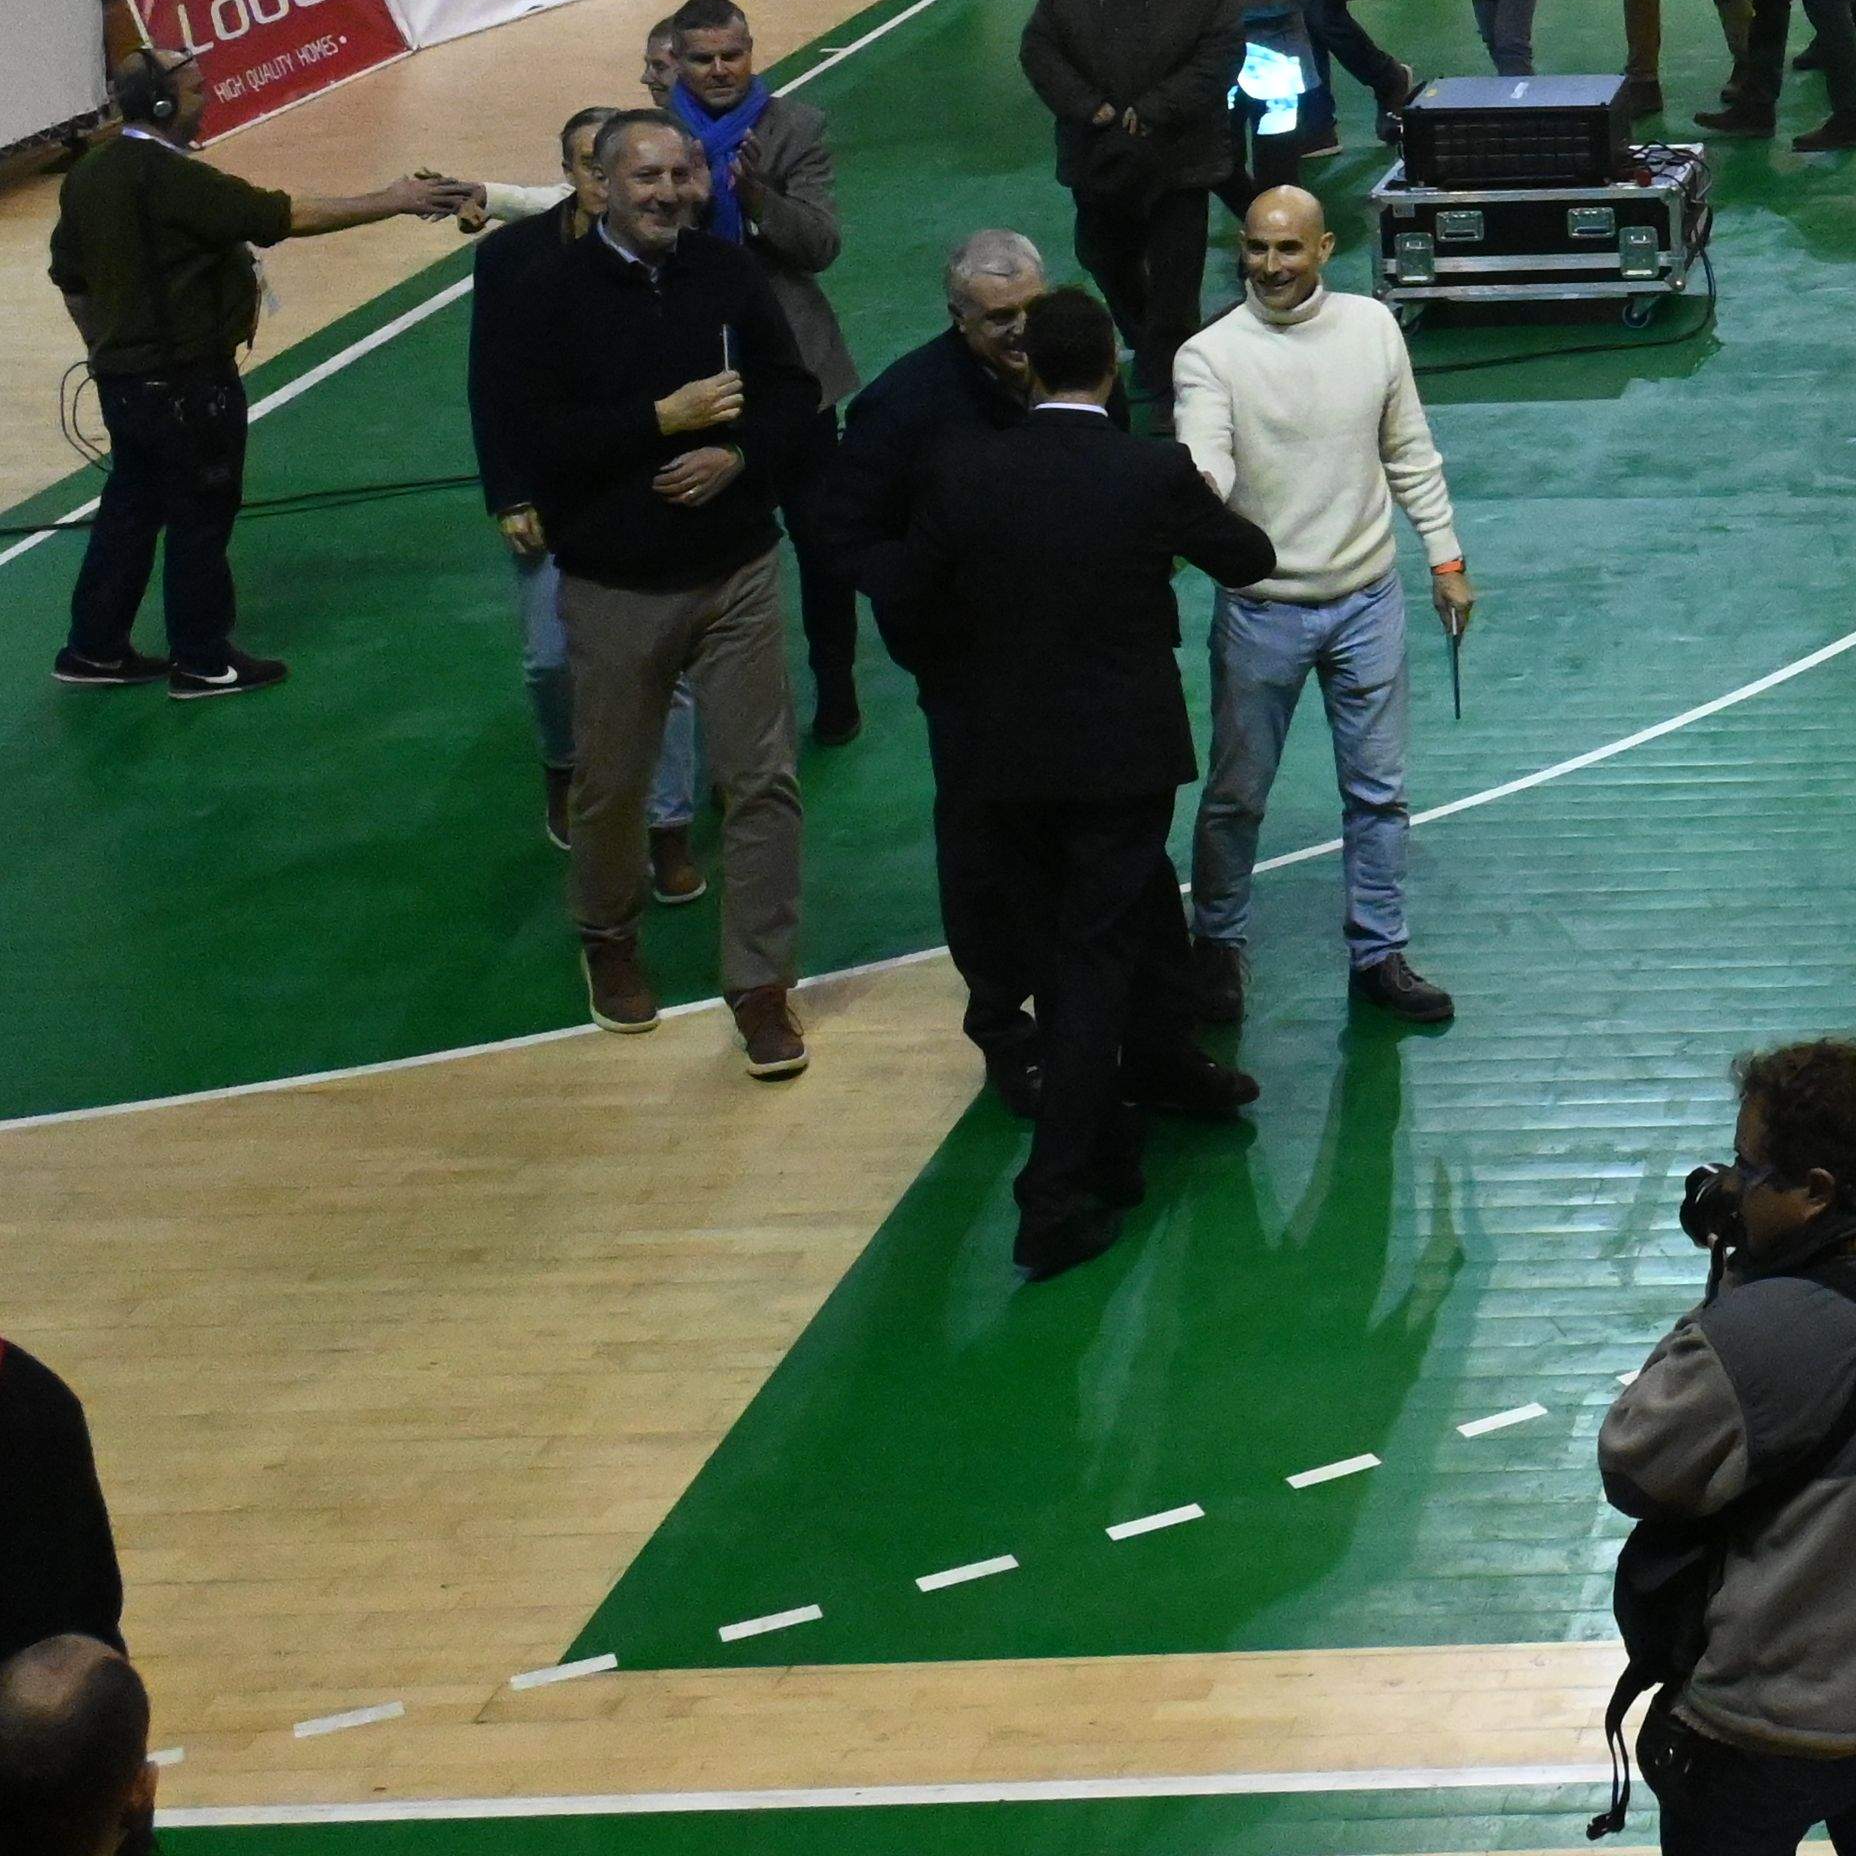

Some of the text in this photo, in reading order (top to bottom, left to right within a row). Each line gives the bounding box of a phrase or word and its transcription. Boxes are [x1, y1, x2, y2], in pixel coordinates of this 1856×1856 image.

[213, 34, 340, 104] HIGH QUALITY HOMES
